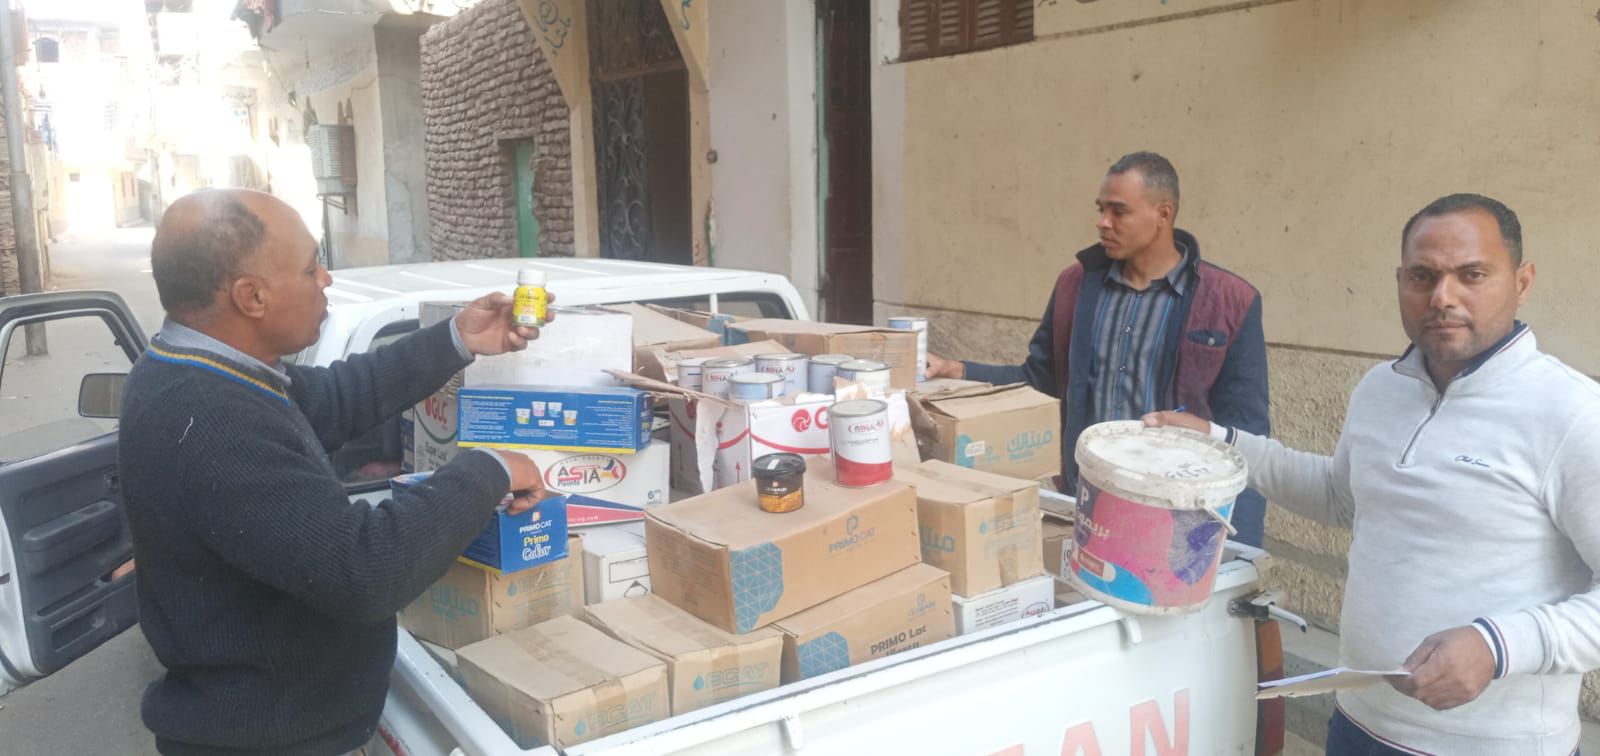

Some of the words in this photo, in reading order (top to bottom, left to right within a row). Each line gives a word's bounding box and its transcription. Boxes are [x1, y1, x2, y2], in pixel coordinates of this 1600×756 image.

[558, 466, 600, 484] ASIA
[524, 535, 549, 546] Primo
[523, 544, 551, 560] Color
[870, 632, 906, 655] PRIMO
[909, 625, 927, 638] Lac
